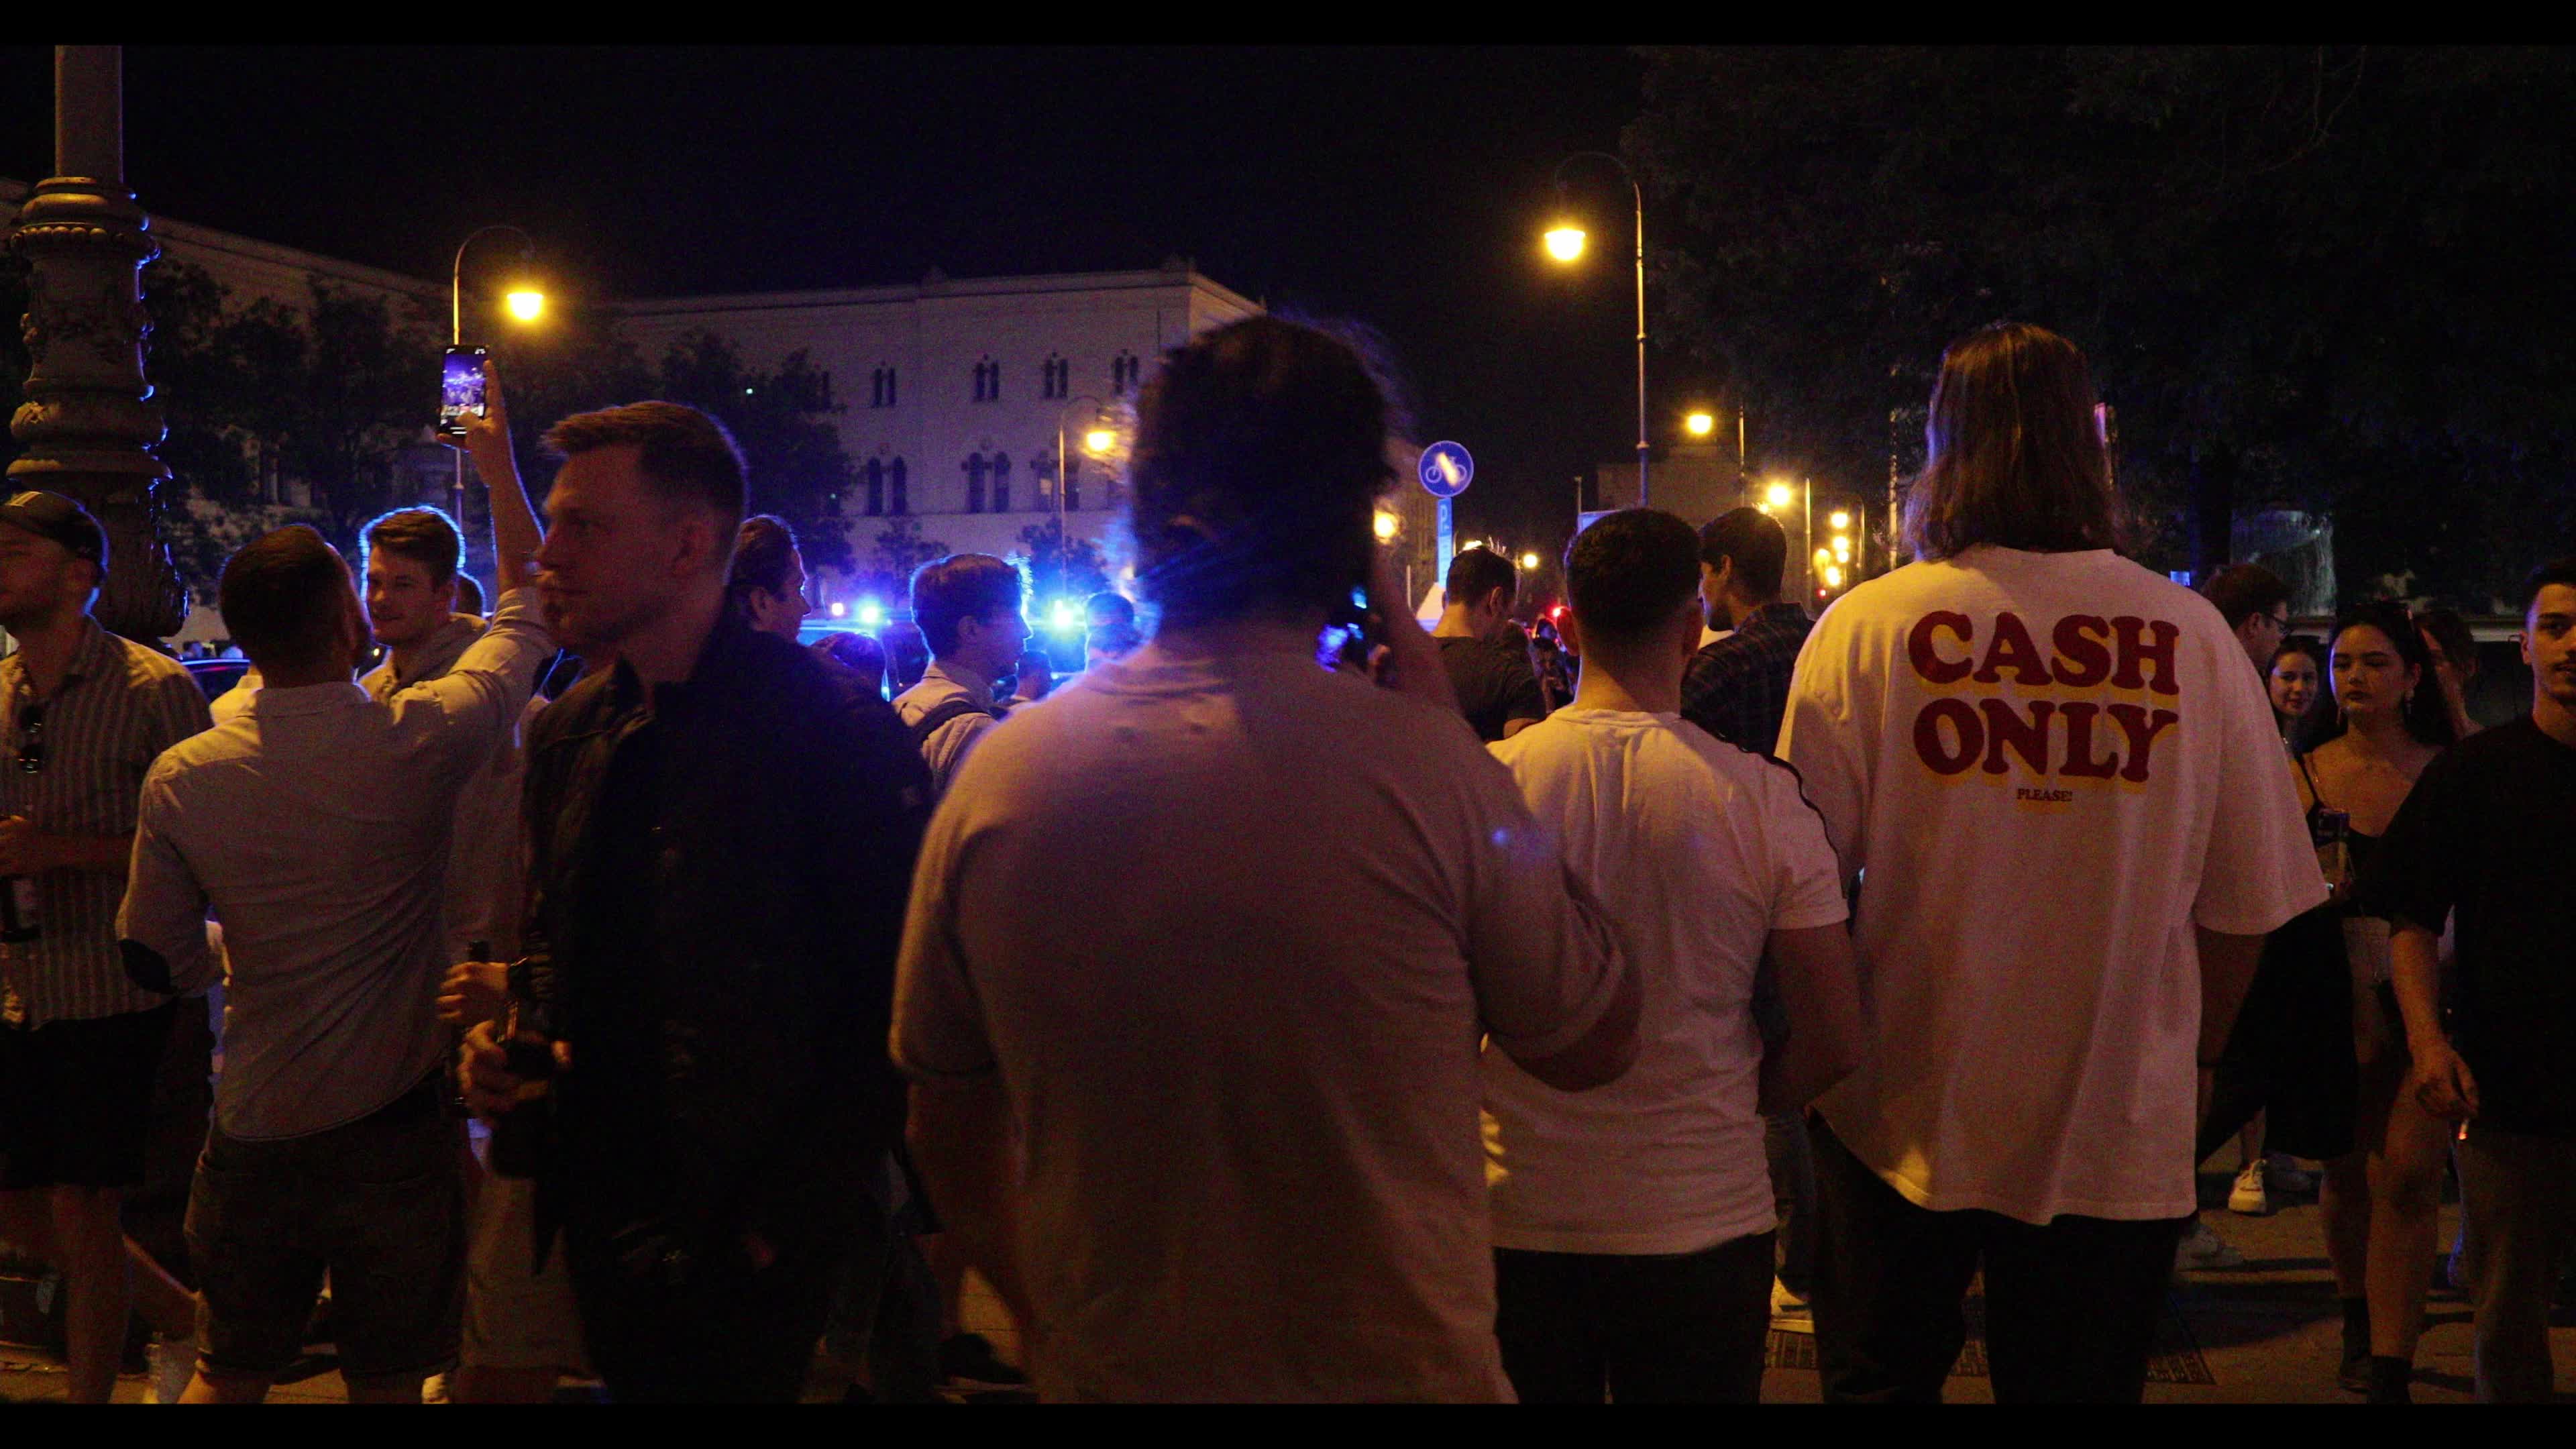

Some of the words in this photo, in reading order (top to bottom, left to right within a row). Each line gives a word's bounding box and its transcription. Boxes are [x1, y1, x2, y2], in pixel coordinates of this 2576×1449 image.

[1908, 610, 2180, 696] CASH
[1913, 698, 2180, 783] ONLY
[2017, 788, 2073, 802] PLEASE!
